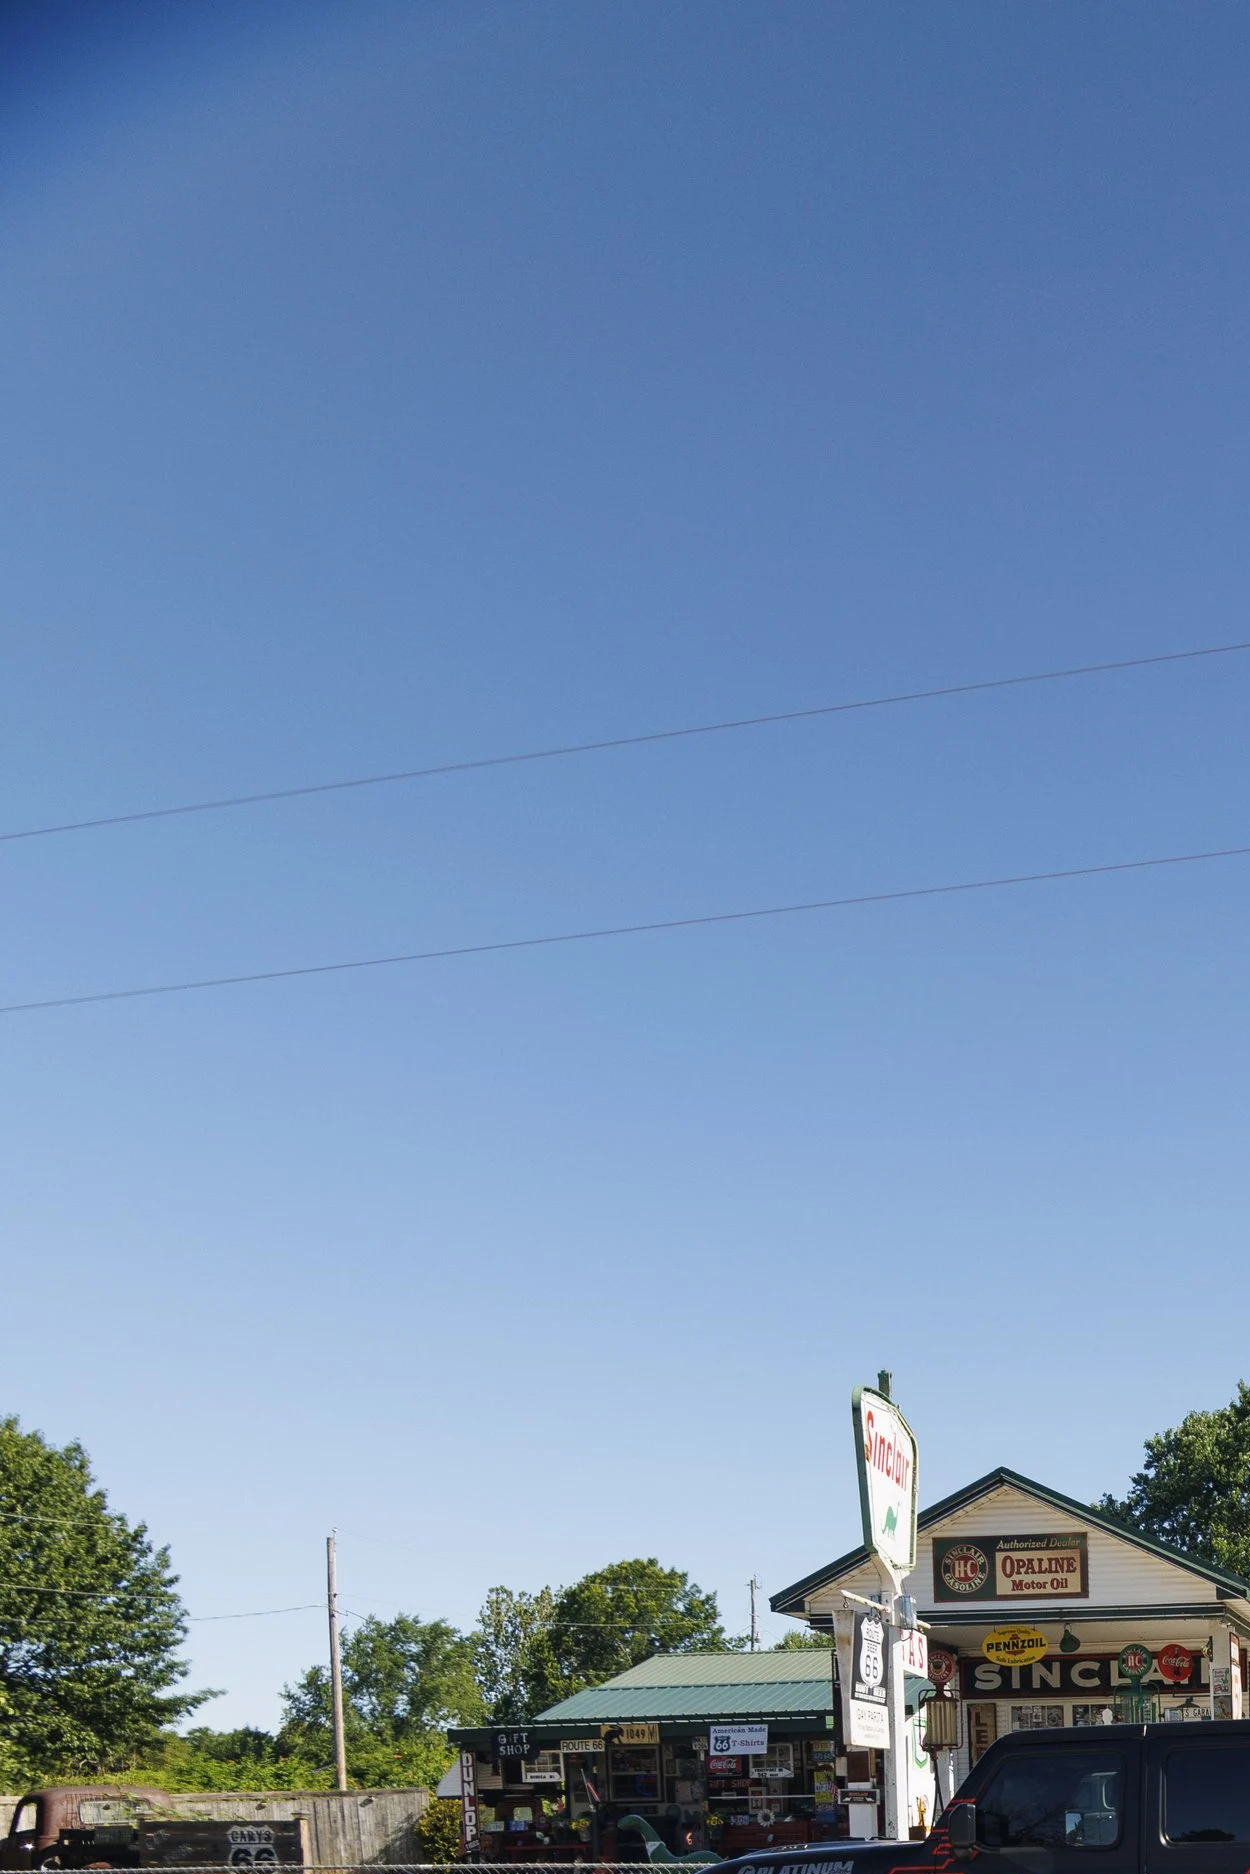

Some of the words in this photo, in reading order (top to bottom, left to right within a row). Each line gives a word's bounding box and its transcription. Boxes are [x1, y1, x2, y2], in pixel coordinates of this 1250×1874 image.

[866, 1410, 909, 1491] Sinclair
[996, 1539, 1046, 1550] Authorized
[1049, 1537, 1080, 1548] Dealer
[944, 1546, 985, 1566] SINCLAIR
[1001, 1555, 1077, 1579] OPALINE
[944, 1571, 986, 1592] GASOLINE
[1011, 1579, 1048, 1592] Motor
[1050, 1578, 1068, 1591] Oil
[987, 1637, 1046, 1653] PENNZOIL
[865, 1655, 878, 1679] 66
[974, 1658, 1210, 1690] SINCLAI
[626, 1729, 645, 1740] 1049
[712, 1726, 745, 1734] American
[498, 1732, 528, 1744] GIFT
[731, 1739, 764, 1747] T-Shirts
[500, 1744, 530, 1756] SHOP
[562, 1740, 590, 1751] ROUTE
[592, 1740, 602, 1750] 66
[715, 1741, 728, 1750] 66
[462, 1752, 477, 1842] DUNLOP
